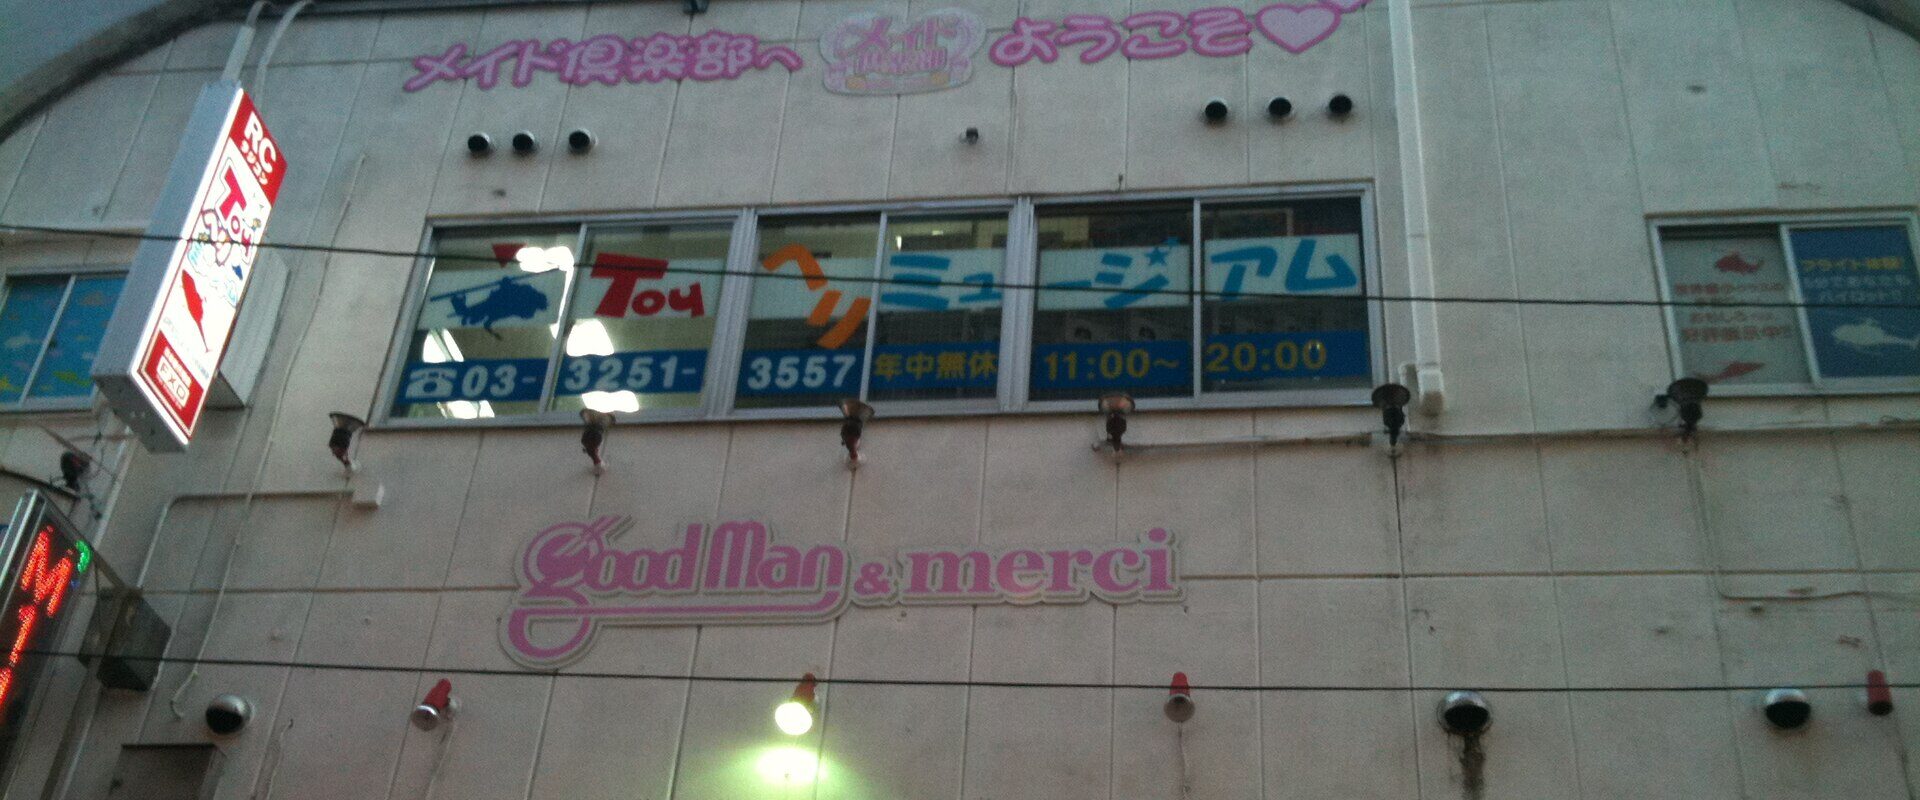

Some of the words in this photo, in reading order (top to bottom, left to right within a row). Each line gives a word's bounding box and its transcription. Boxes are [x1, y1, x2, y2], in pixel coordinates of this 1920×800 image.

[989, 6, 1253, 67] ようこそ
[243, 110, 278, 173] RC
[590, 252, 705, 319] Toy
[873, 350, 998, 383] 年中無休
[853, 561, 891, 596] &
[904, 526, 1178, 597] merci
